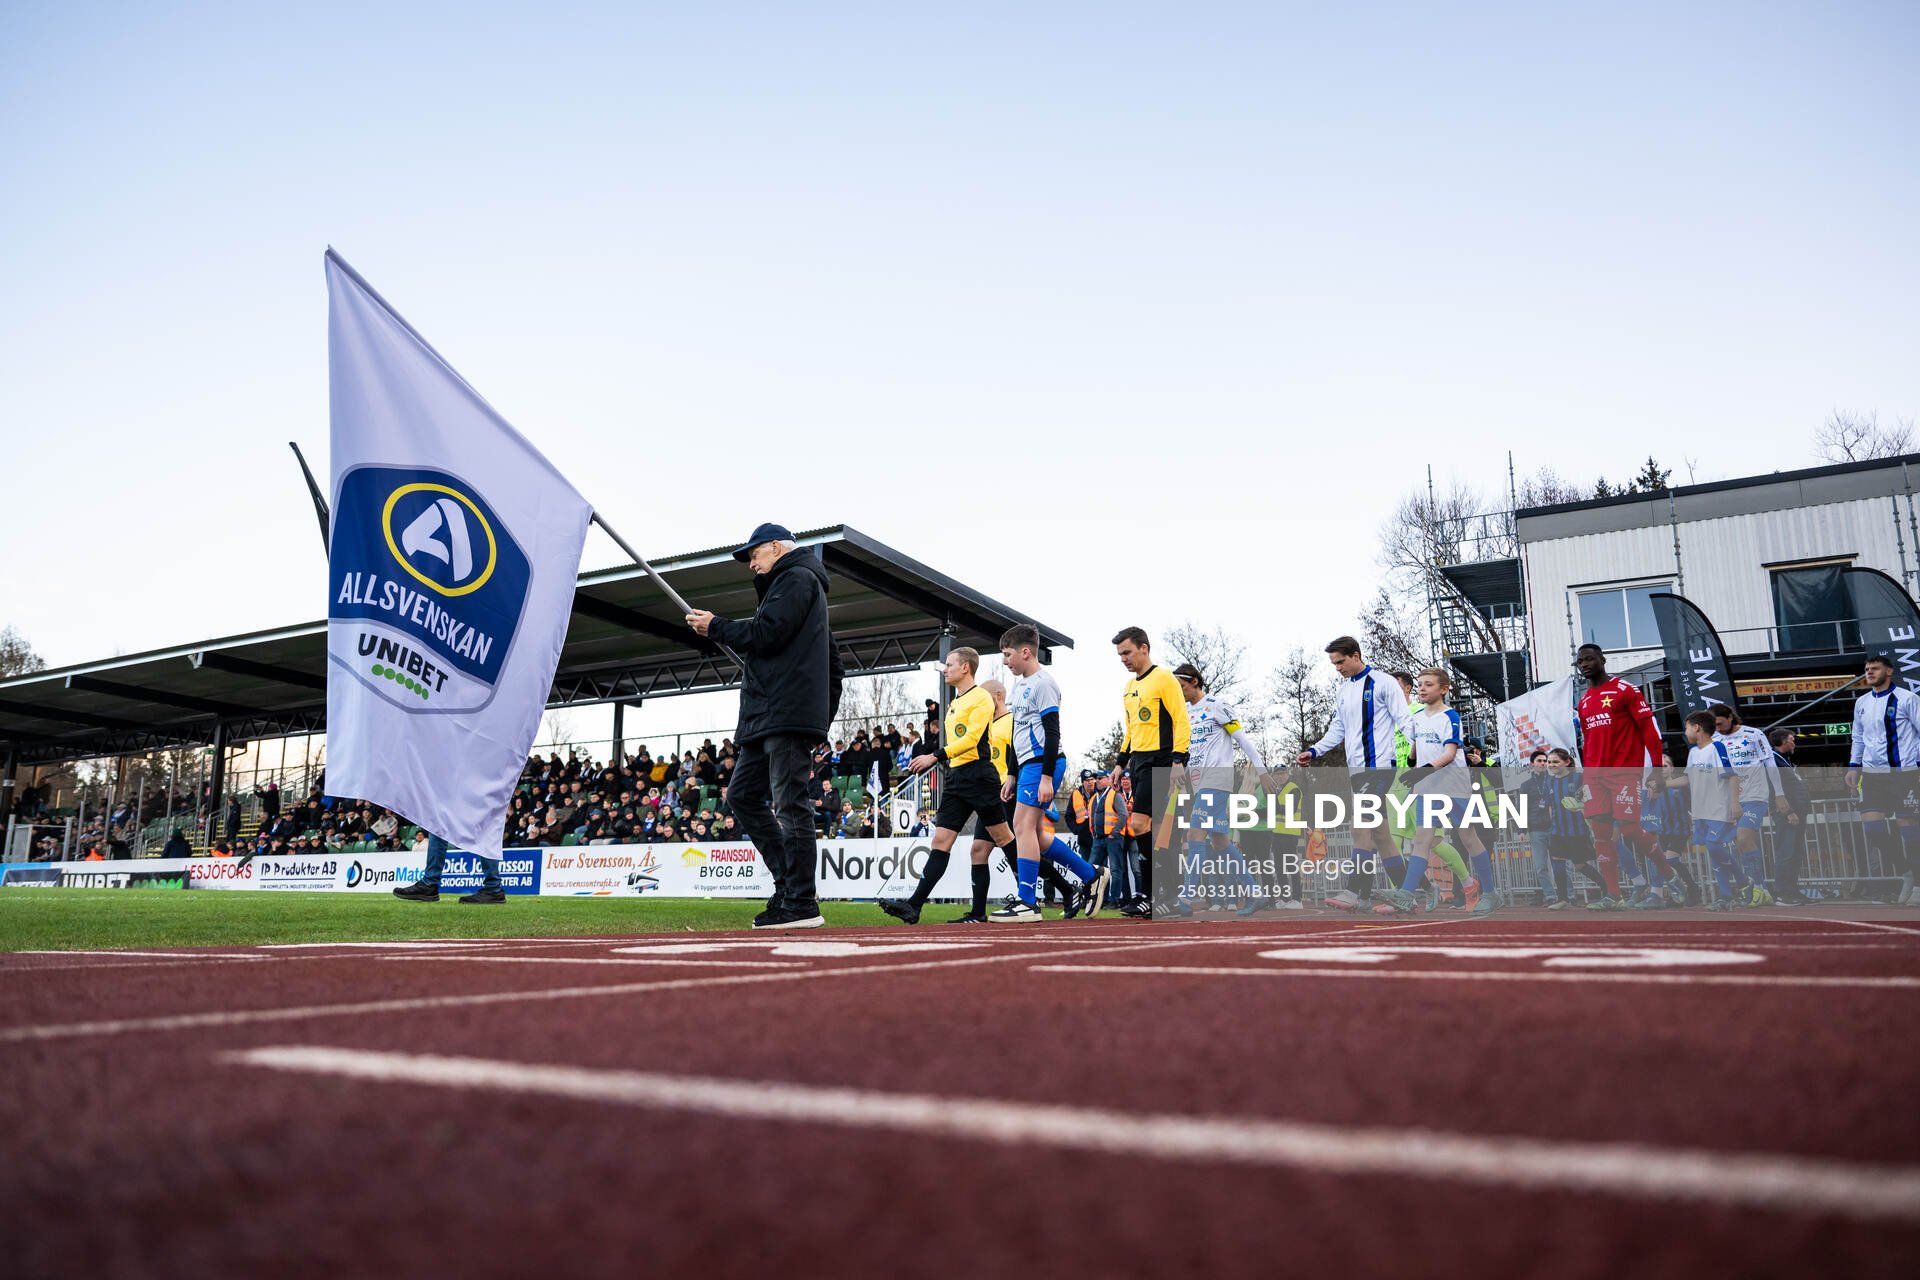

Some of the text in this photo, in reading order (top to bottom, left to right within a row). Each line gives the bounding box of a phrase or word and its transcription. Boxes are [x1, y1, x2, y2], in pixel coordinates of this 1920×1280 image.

[337, 571, 493, 665] ALLSVENSKAN
[357, 633, 449, 694] UNIBET
[546, 845, 656, 870] Ivar Svensson, Ås
[710, 848, 756, 863] FRANSSON
[260, 861, 337, 876] IP Produkter AB
[443, 857, 534, 875] Dick Jonsson
[699, 866, 754, 878] BYGG AB
[440, 876, 533, 887] SKOGSTRANRTER AB
